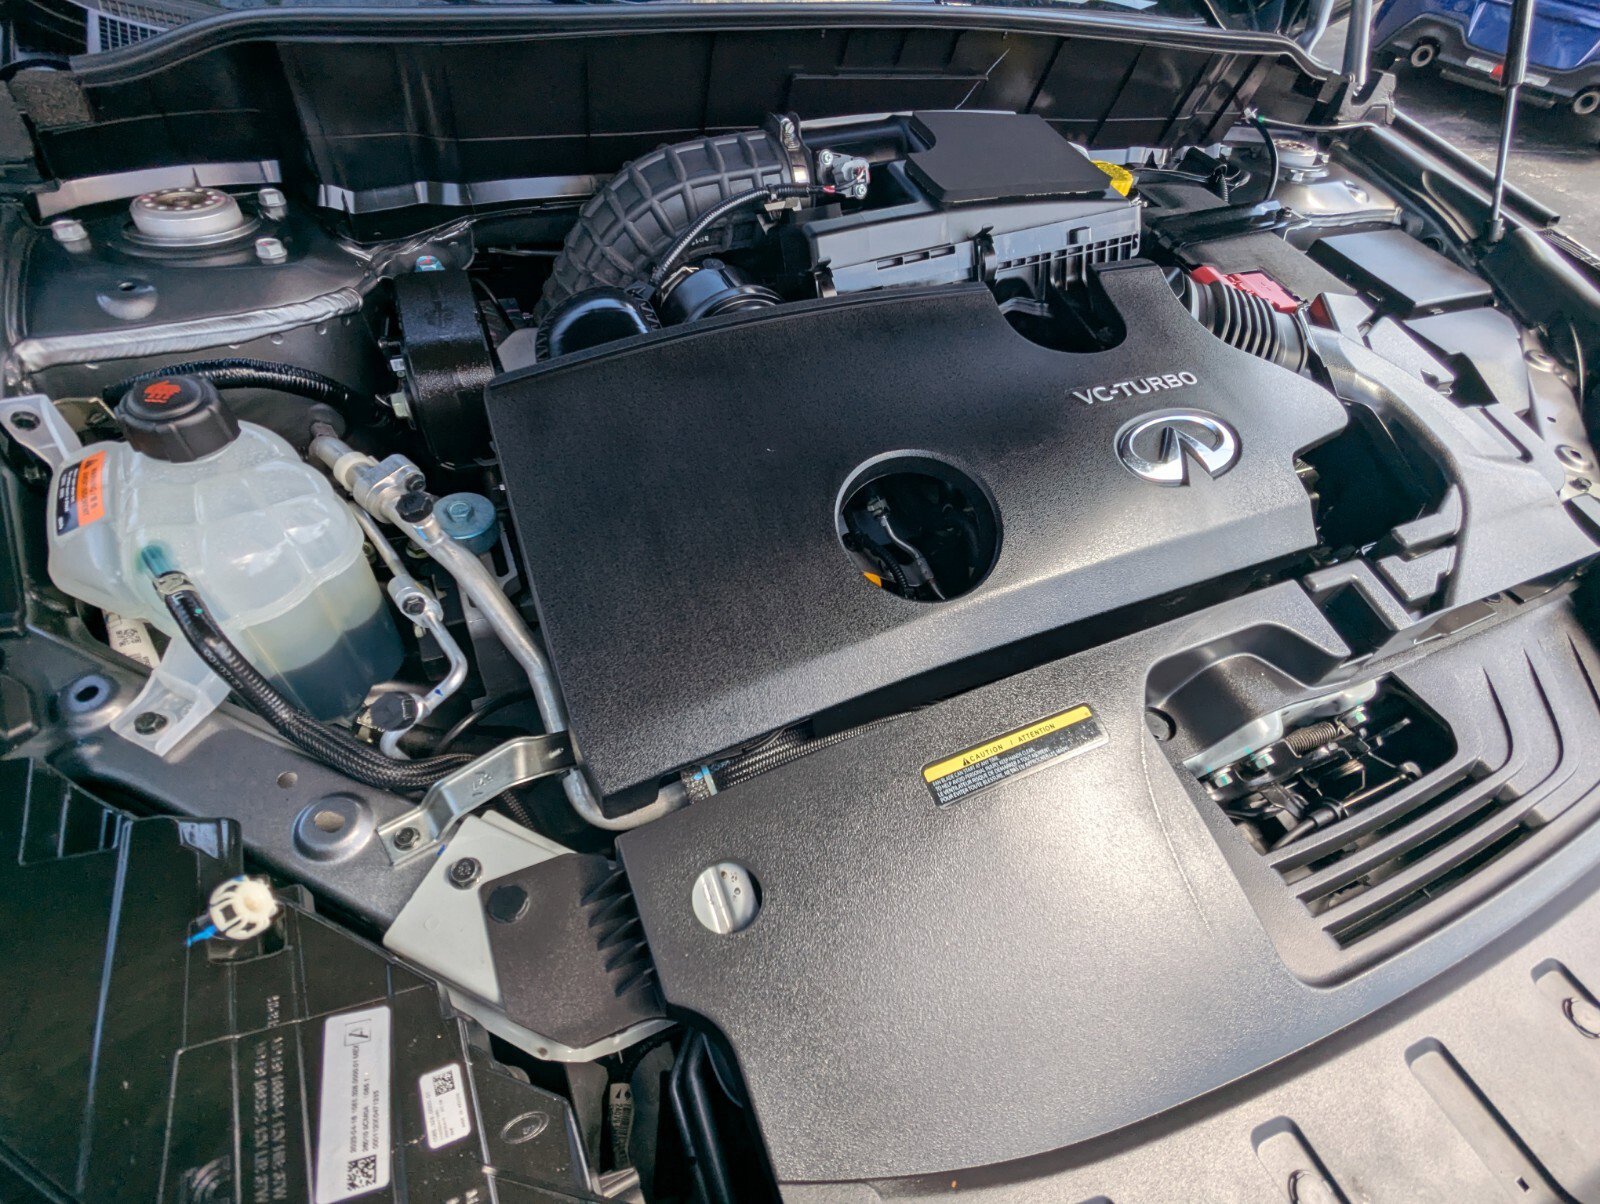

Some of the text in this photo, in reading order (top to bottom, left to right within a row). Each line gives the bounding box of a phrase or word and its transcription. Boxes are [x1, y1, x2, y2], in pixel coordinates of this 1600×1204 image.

[1073, 371, 1198, 405] VC-TURBO
[969, 744, 1004, 761] CAUTION
[1017, 723, 1056, 742] ATTENTION
